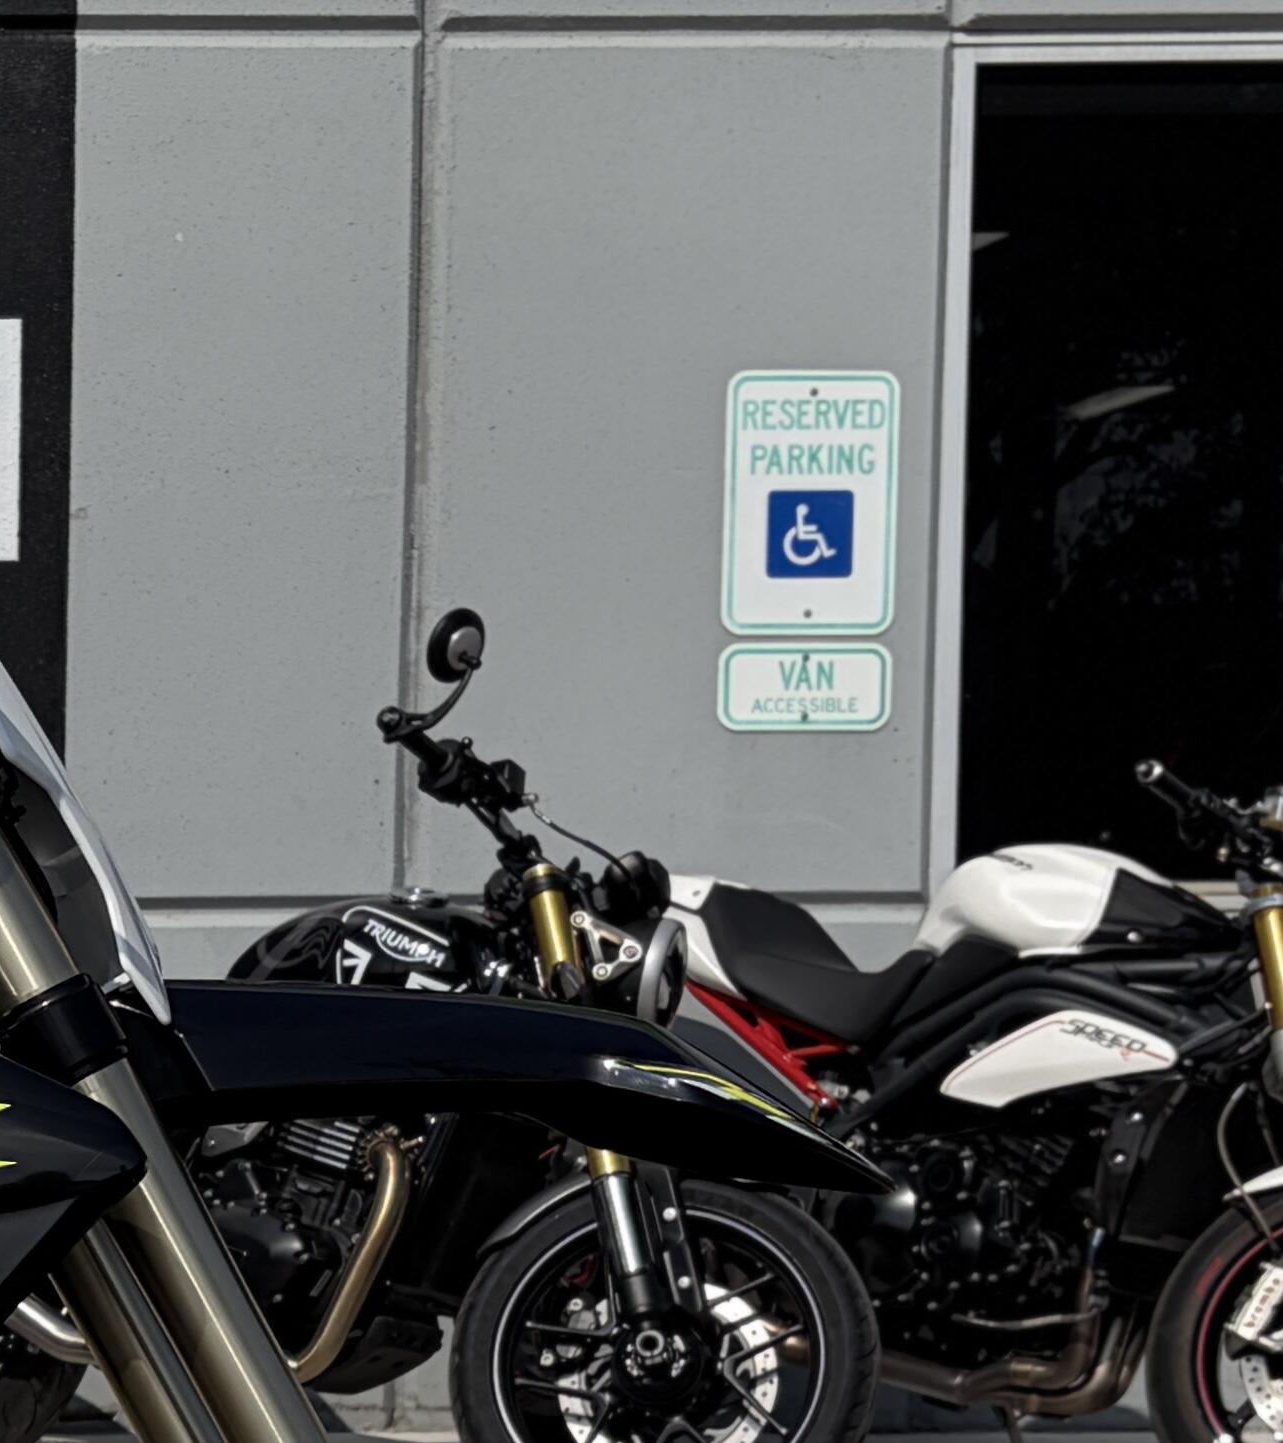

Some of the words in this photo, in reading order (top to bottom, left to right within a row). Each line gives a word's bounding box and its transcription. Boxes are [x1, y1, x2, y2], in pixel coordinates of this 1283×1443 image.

[741, 398, 886, 431] RESERVED
[749, 444, 876, 476] PARKING
[778, 661, 834, 691] VAN
[751, 697, 859, 715] ACCESSIBLE
[362, 917, 446, 969] TRIUMPH
[1059, 1018, 1147, 1053] SPEED
